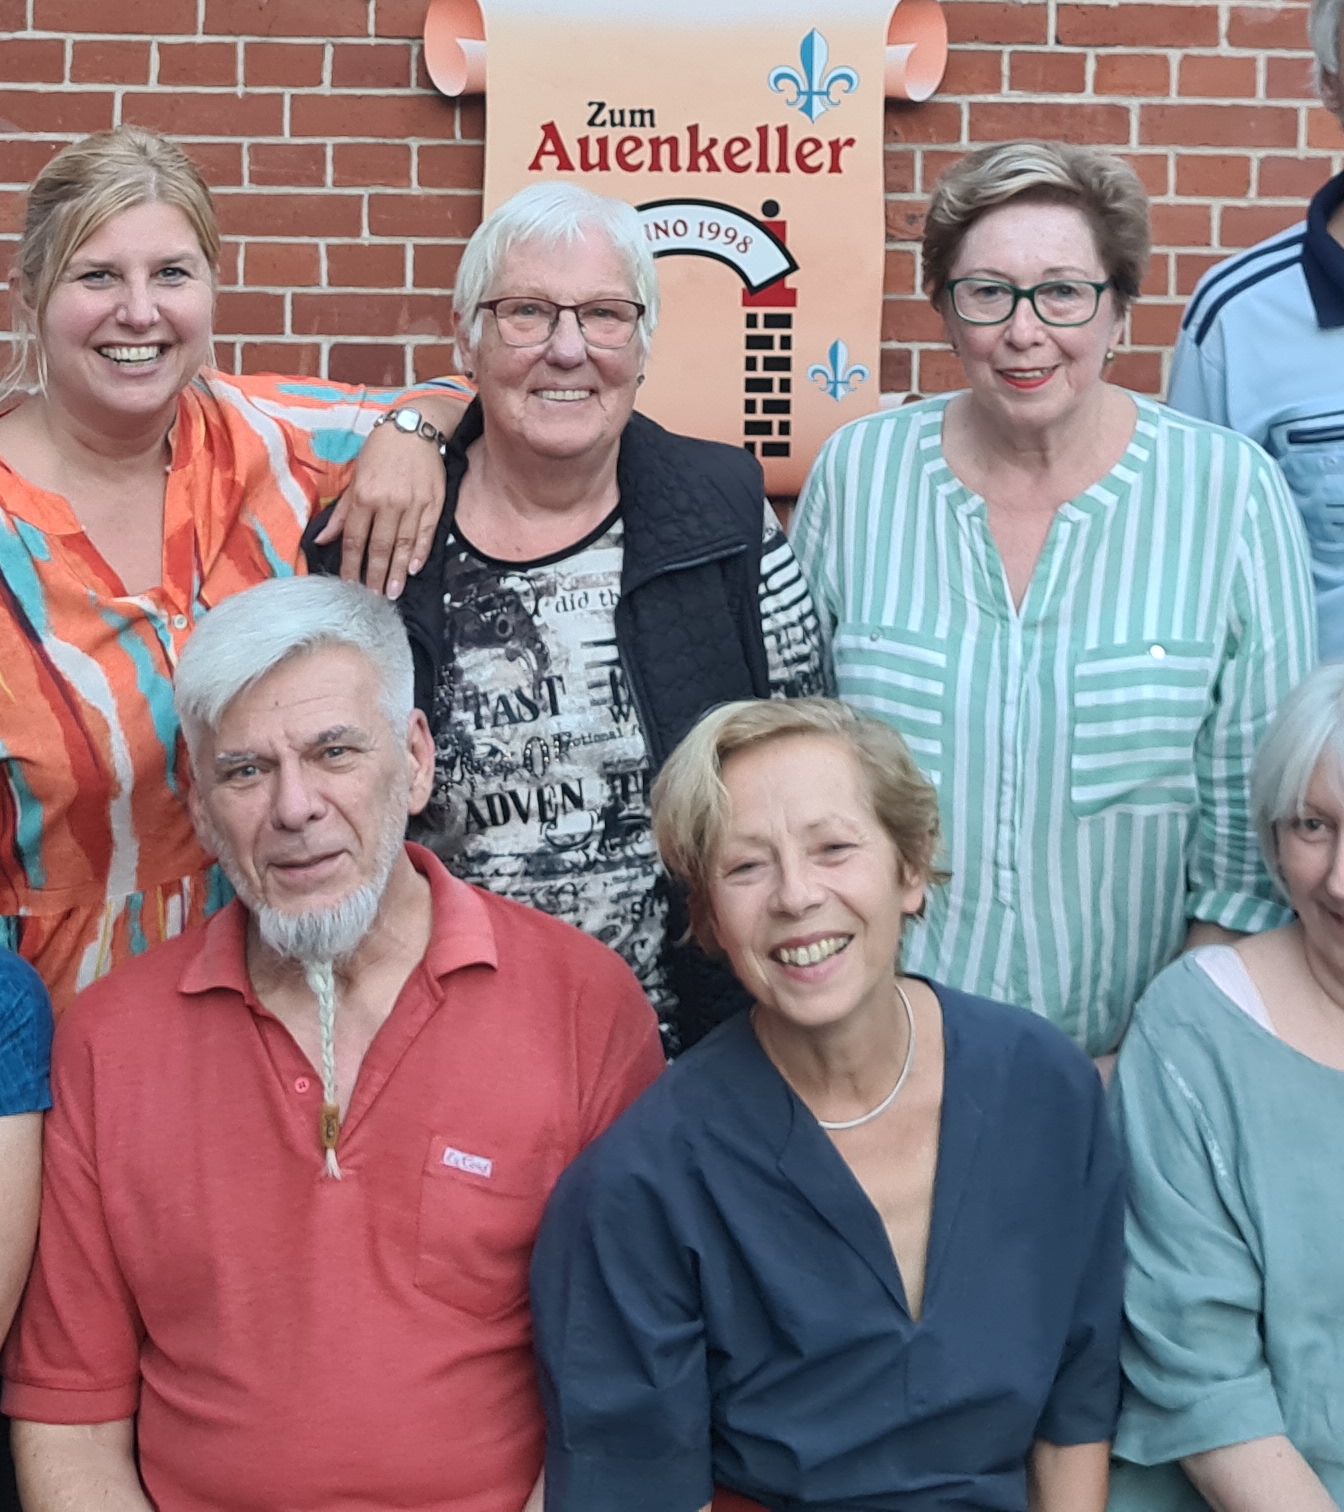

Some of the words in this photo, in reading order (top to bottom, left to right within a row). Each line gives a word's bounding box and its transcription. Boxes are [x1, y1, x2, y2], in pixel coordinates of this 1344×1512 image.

[586, 101, 656, 129] Zum
[528, 120, 857, 174] Auenkeller
[698, 220, 754, 254] 1998
